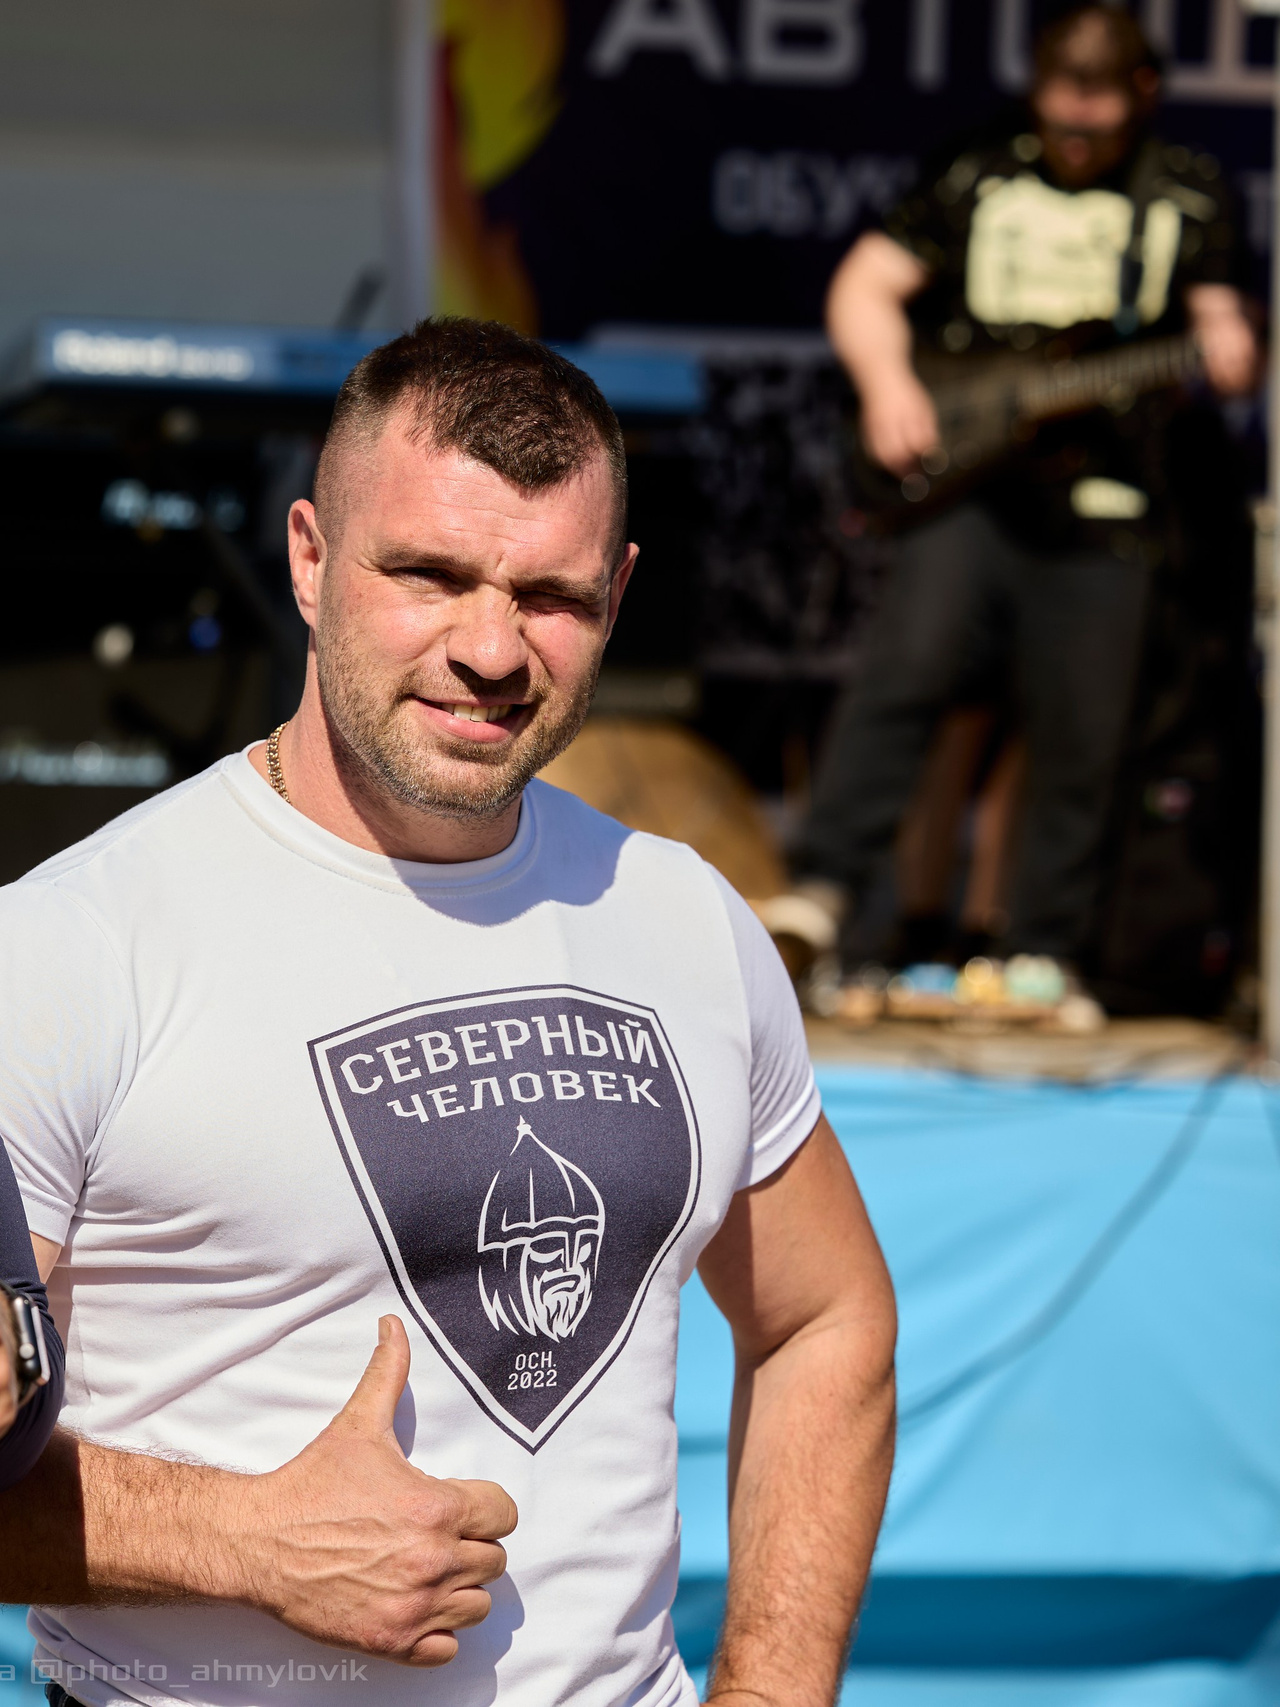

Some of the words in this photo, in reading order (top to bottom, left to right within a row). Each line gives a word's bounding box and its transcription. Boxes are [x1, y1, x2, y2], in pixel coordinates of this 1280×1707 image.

[340, 1014, 658, 1094] СЕВЕРНЫЙ
[387, 1070, 661, 1123] ЧЕЛОВЕК
[507, 1369, 558, 1390] 2022
[515, 1351, 557, 1371] ОСН.
